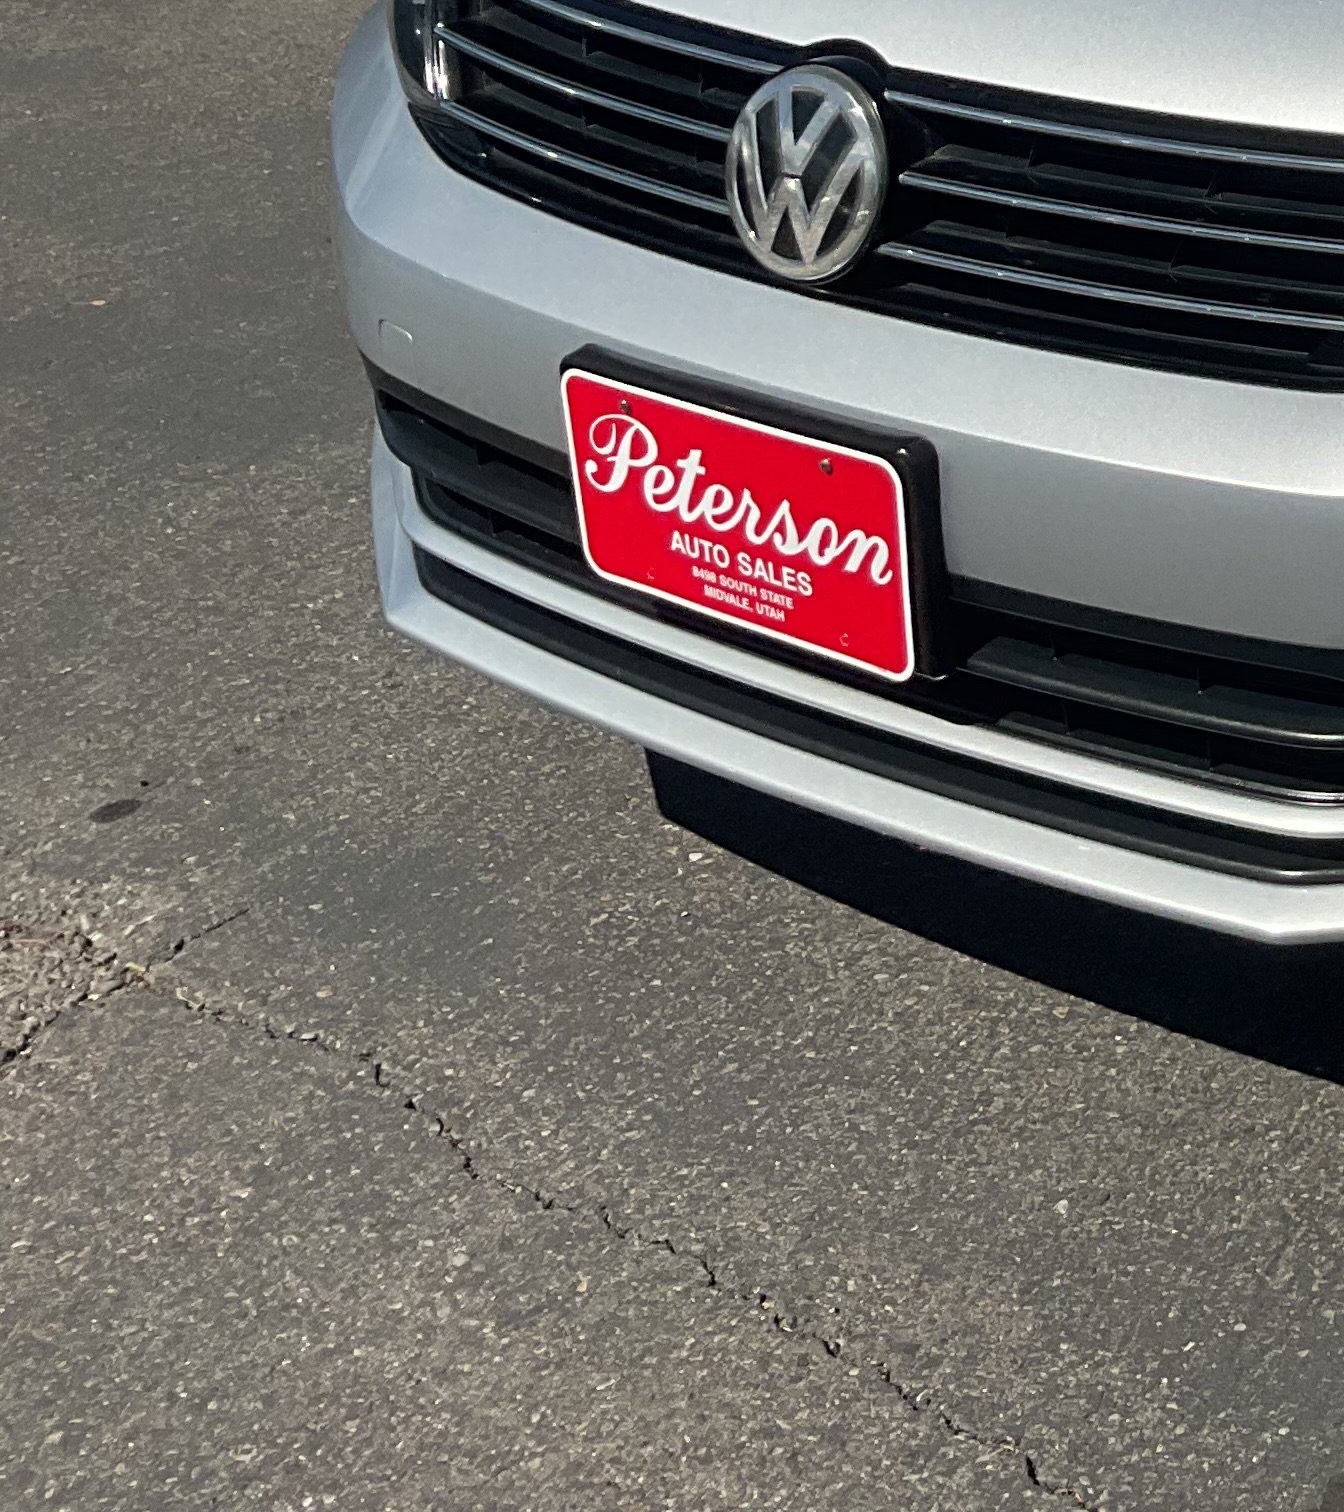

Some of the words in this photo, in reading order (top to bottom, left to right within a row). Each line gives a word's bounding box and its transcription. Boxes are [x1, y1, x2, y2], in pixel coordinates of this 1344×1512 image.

[585, 413, 893, 585] Peterson
[671, 530, 730, 568] AUTO
[737, 552, 813, 596] SALES
[692, 565, 717, 583] 8498
[719, 574, 758, 597] SOUTH
[759, 588, 794, 610] STATE
[703, 584, 753, 612] MIDVALE,
[755, 602, 785, 622] UTAH
